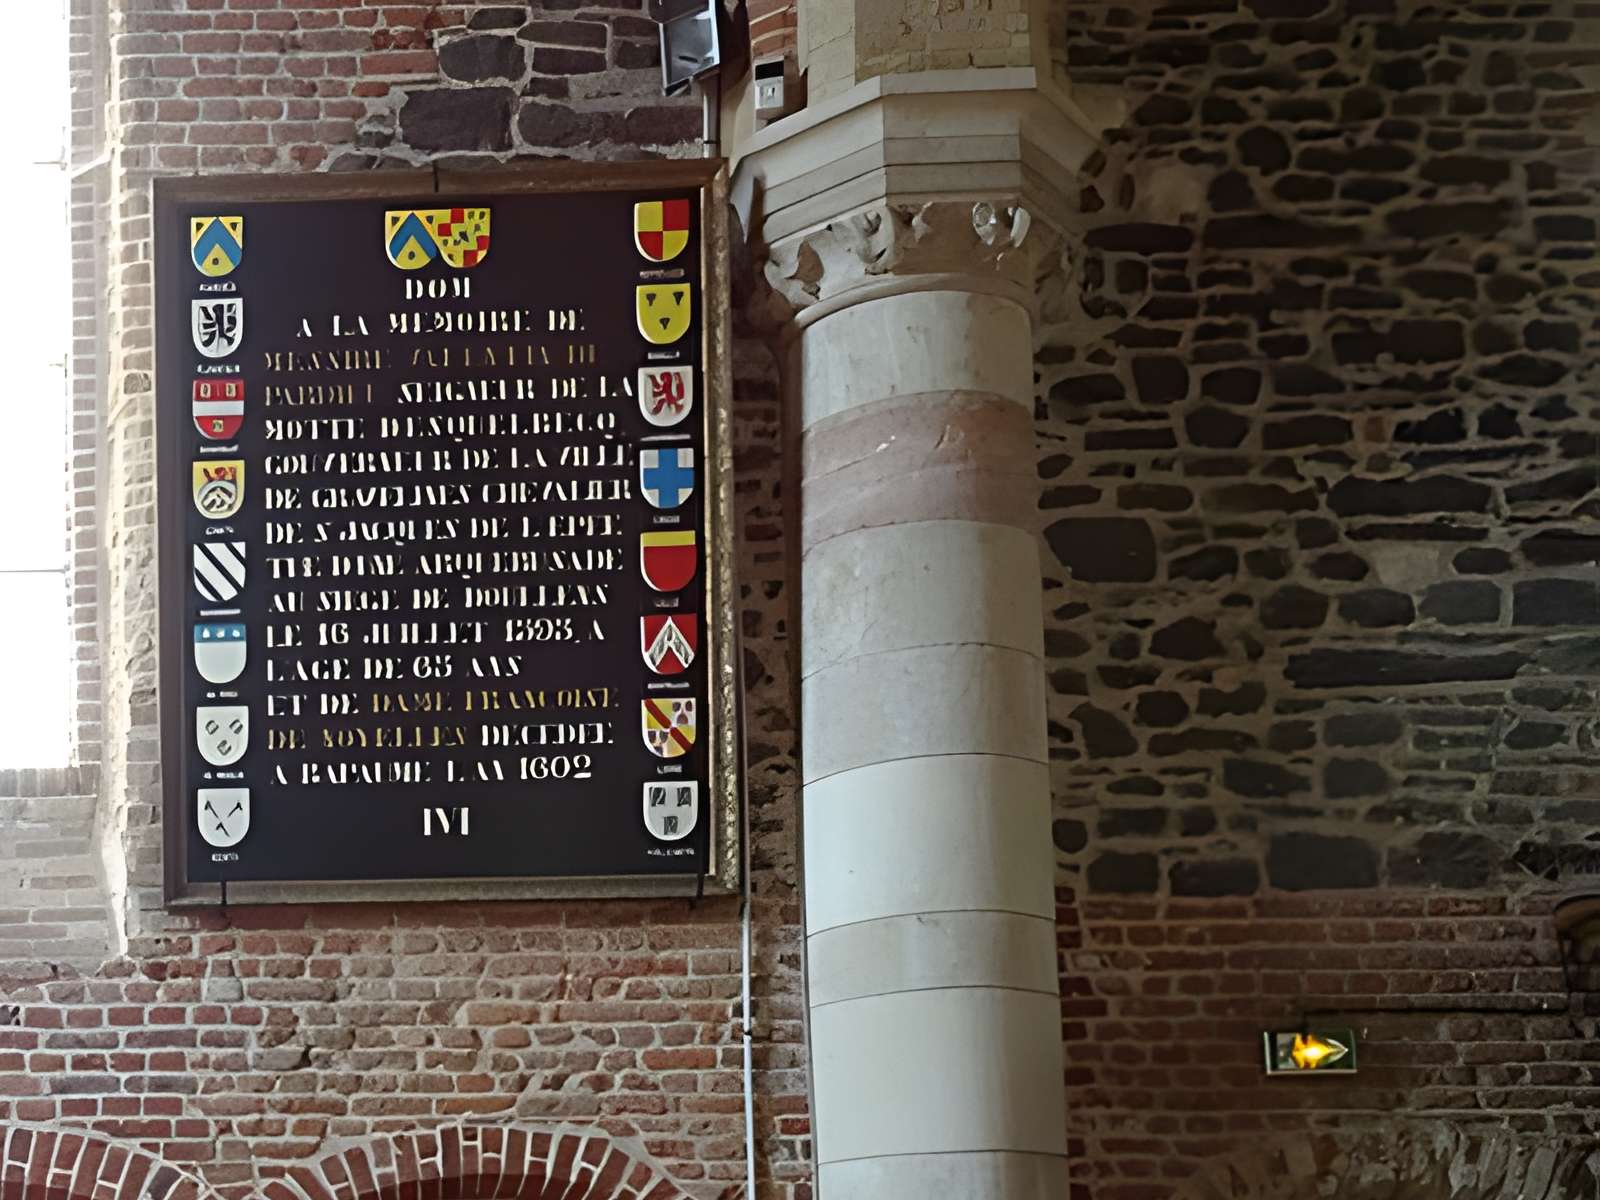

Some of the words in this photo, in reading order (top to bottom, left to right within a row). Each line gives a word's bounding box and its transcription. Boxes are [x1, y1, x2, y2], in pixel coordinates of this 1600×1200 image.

[296, 318, 312, 338] A
[333, 315, 369, 336] LA
[389, 310, 531, 334] MEMOIRE
[548, 308, 585, 331] DE
[552, 378, 588, 399] DE
[600, 376, 633, 398] LA
[265, 418, 364, 441] MOTTE
[463, 448, 498, 471] DE
[511, 446, 548, 469] LA
[559, 443, 634, 467] VILLE
[265, 488, 301, 509] DE
[265, 522, 303, 544] DE
[471, 518, 508, 539] DE
[269, 591, 304, 612] AU
[413, 588, 449, 609] DE
[266, 624, 301, 648] LE
[363, 657, 402, 679] DE
[266, 694, 307, 716] ET
[320, 693, 359, 714] DE
[268, 728, 306, 749] DE
[519, 754, 592, 780] 1602
